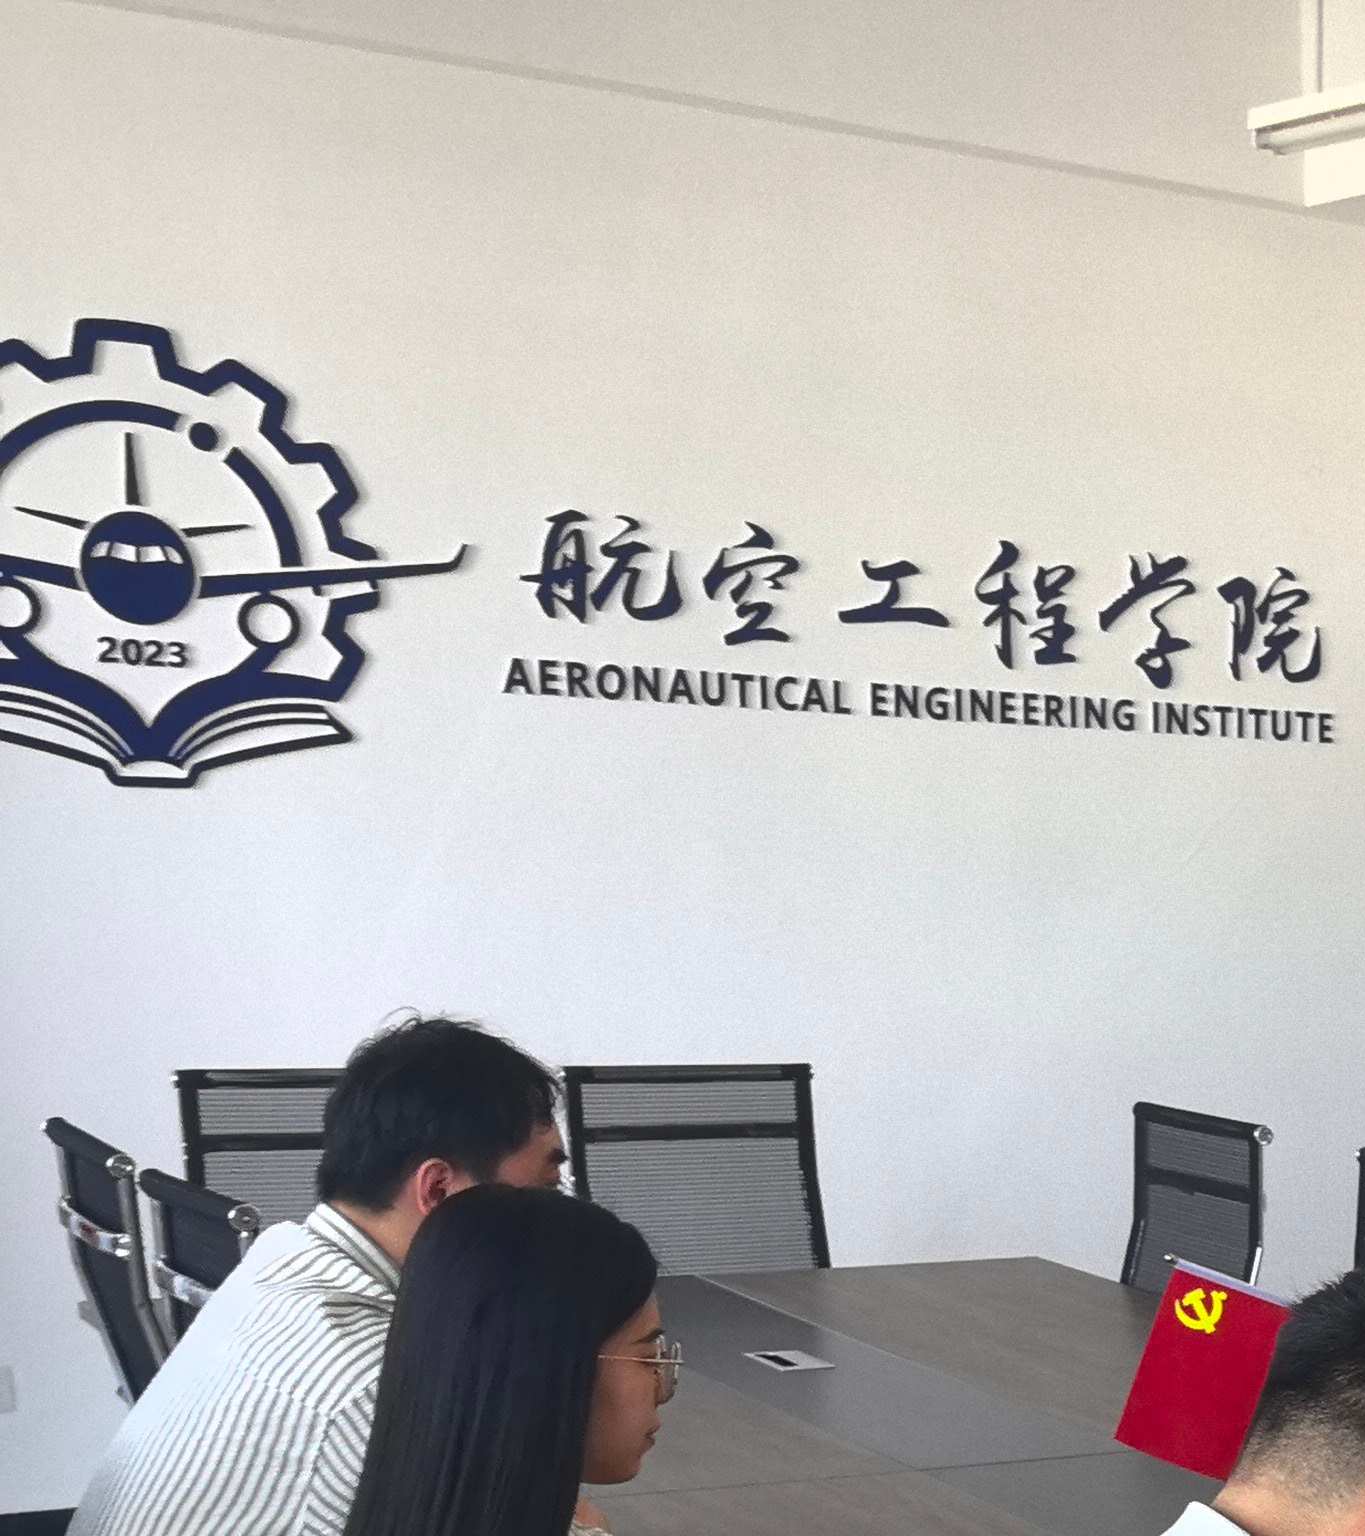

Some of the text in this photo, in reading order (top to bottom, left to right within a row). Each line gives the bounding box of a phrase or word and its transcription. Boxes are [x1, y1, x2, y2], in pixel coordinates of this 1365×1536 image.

[519, 509, 1322, 689] 航空工程学院
[97, 636, 189, 668] 2023
[502, 657, 1335, 744] AERONAUTICAL ENGINEERING INSTITUTE
